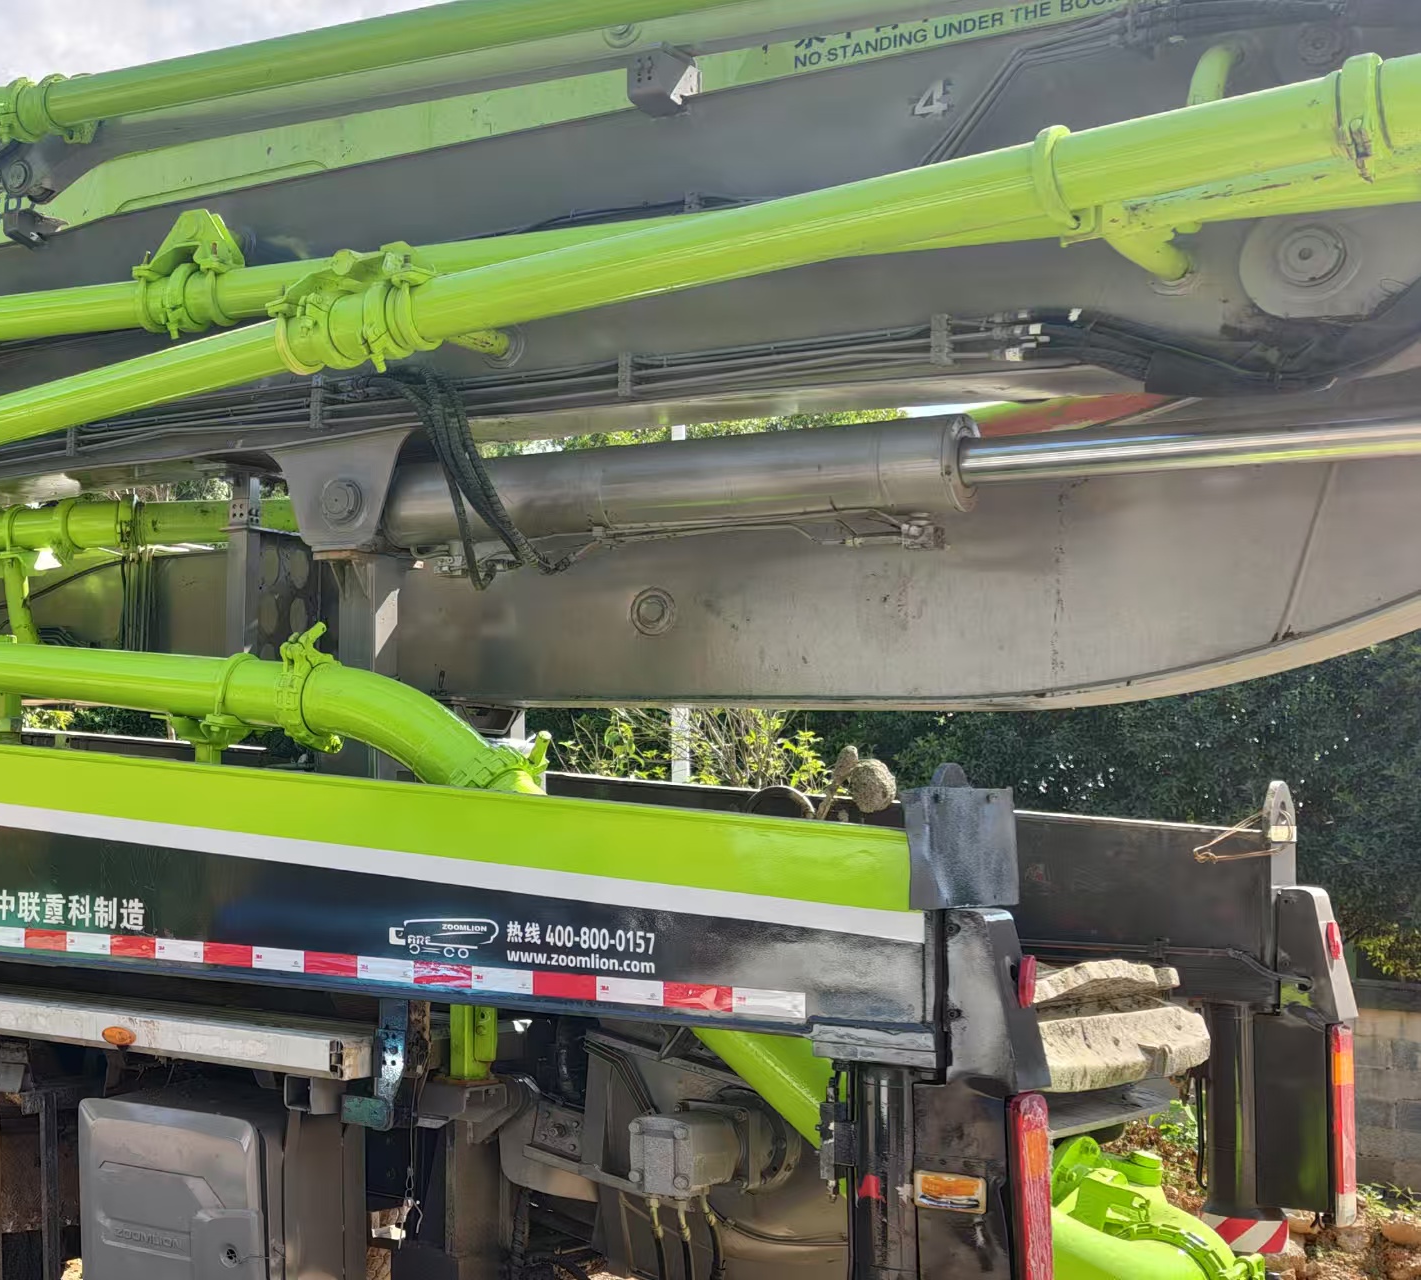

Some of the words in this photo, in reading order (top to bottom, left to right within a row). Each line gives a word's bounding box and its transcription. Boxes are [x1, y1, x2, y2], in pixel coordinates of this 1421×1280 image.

[794, 51, 822, 69] NO
[827, 28, 928, 62] STANDING
[934, 12, 1004, 39] UNDER
[1012, 1, 1051, 23] THE
[1061, 0, 1119, 13] BO
[914, 79, 949, 118] 4
[441, 923, 487, 932] ZOOMLION
[506, 921, 541, 945] 热线
[545, 924, 656, 955] 400-800-0157
[506, 949, 656, 974] www.zoomlion.com
[114, 1228, 183, 1248] ZOOMLION
